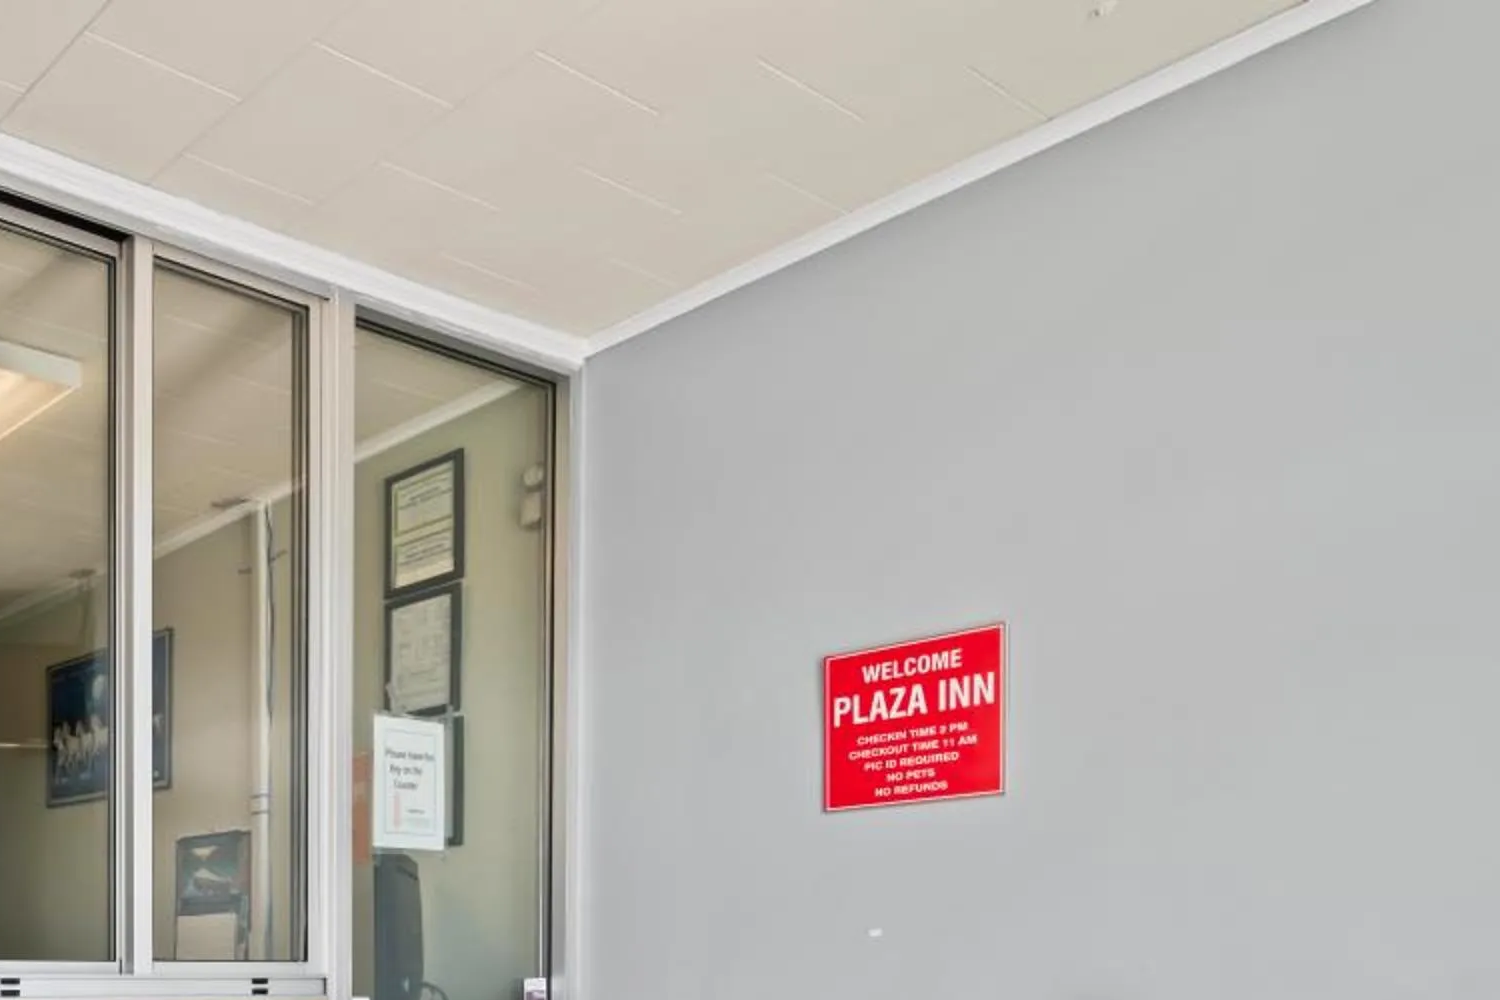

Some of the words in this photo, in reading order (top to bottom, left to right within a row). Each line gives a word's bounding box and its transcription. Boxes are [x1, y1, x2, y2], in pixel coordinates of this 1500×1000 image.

[862, 648, 963, 684] WELCOME
[833, 683, 928, 728] PLAZA
[938, 671, 996, 712] INN
[856, 731, 907, 746] CHECKIN
[909, 725, 937, 738] TIME
[949, 720, 968, 733] PM
[848, 743, 909, 760] CHECKOUT
[911, 739, 940, 752] TIME
[942, 738, 956, 748] 11
[957, 733, 978, 746] AM
[885, 759, 897, 769] ID
[899, 751, 959, 767] REQUIRED
[886, 771, 904, 783] NO
[905, 767, 936, 780] PETS
[874, 787, 891, 798] NO
[893, 780, 949, 795] REFUNDS
